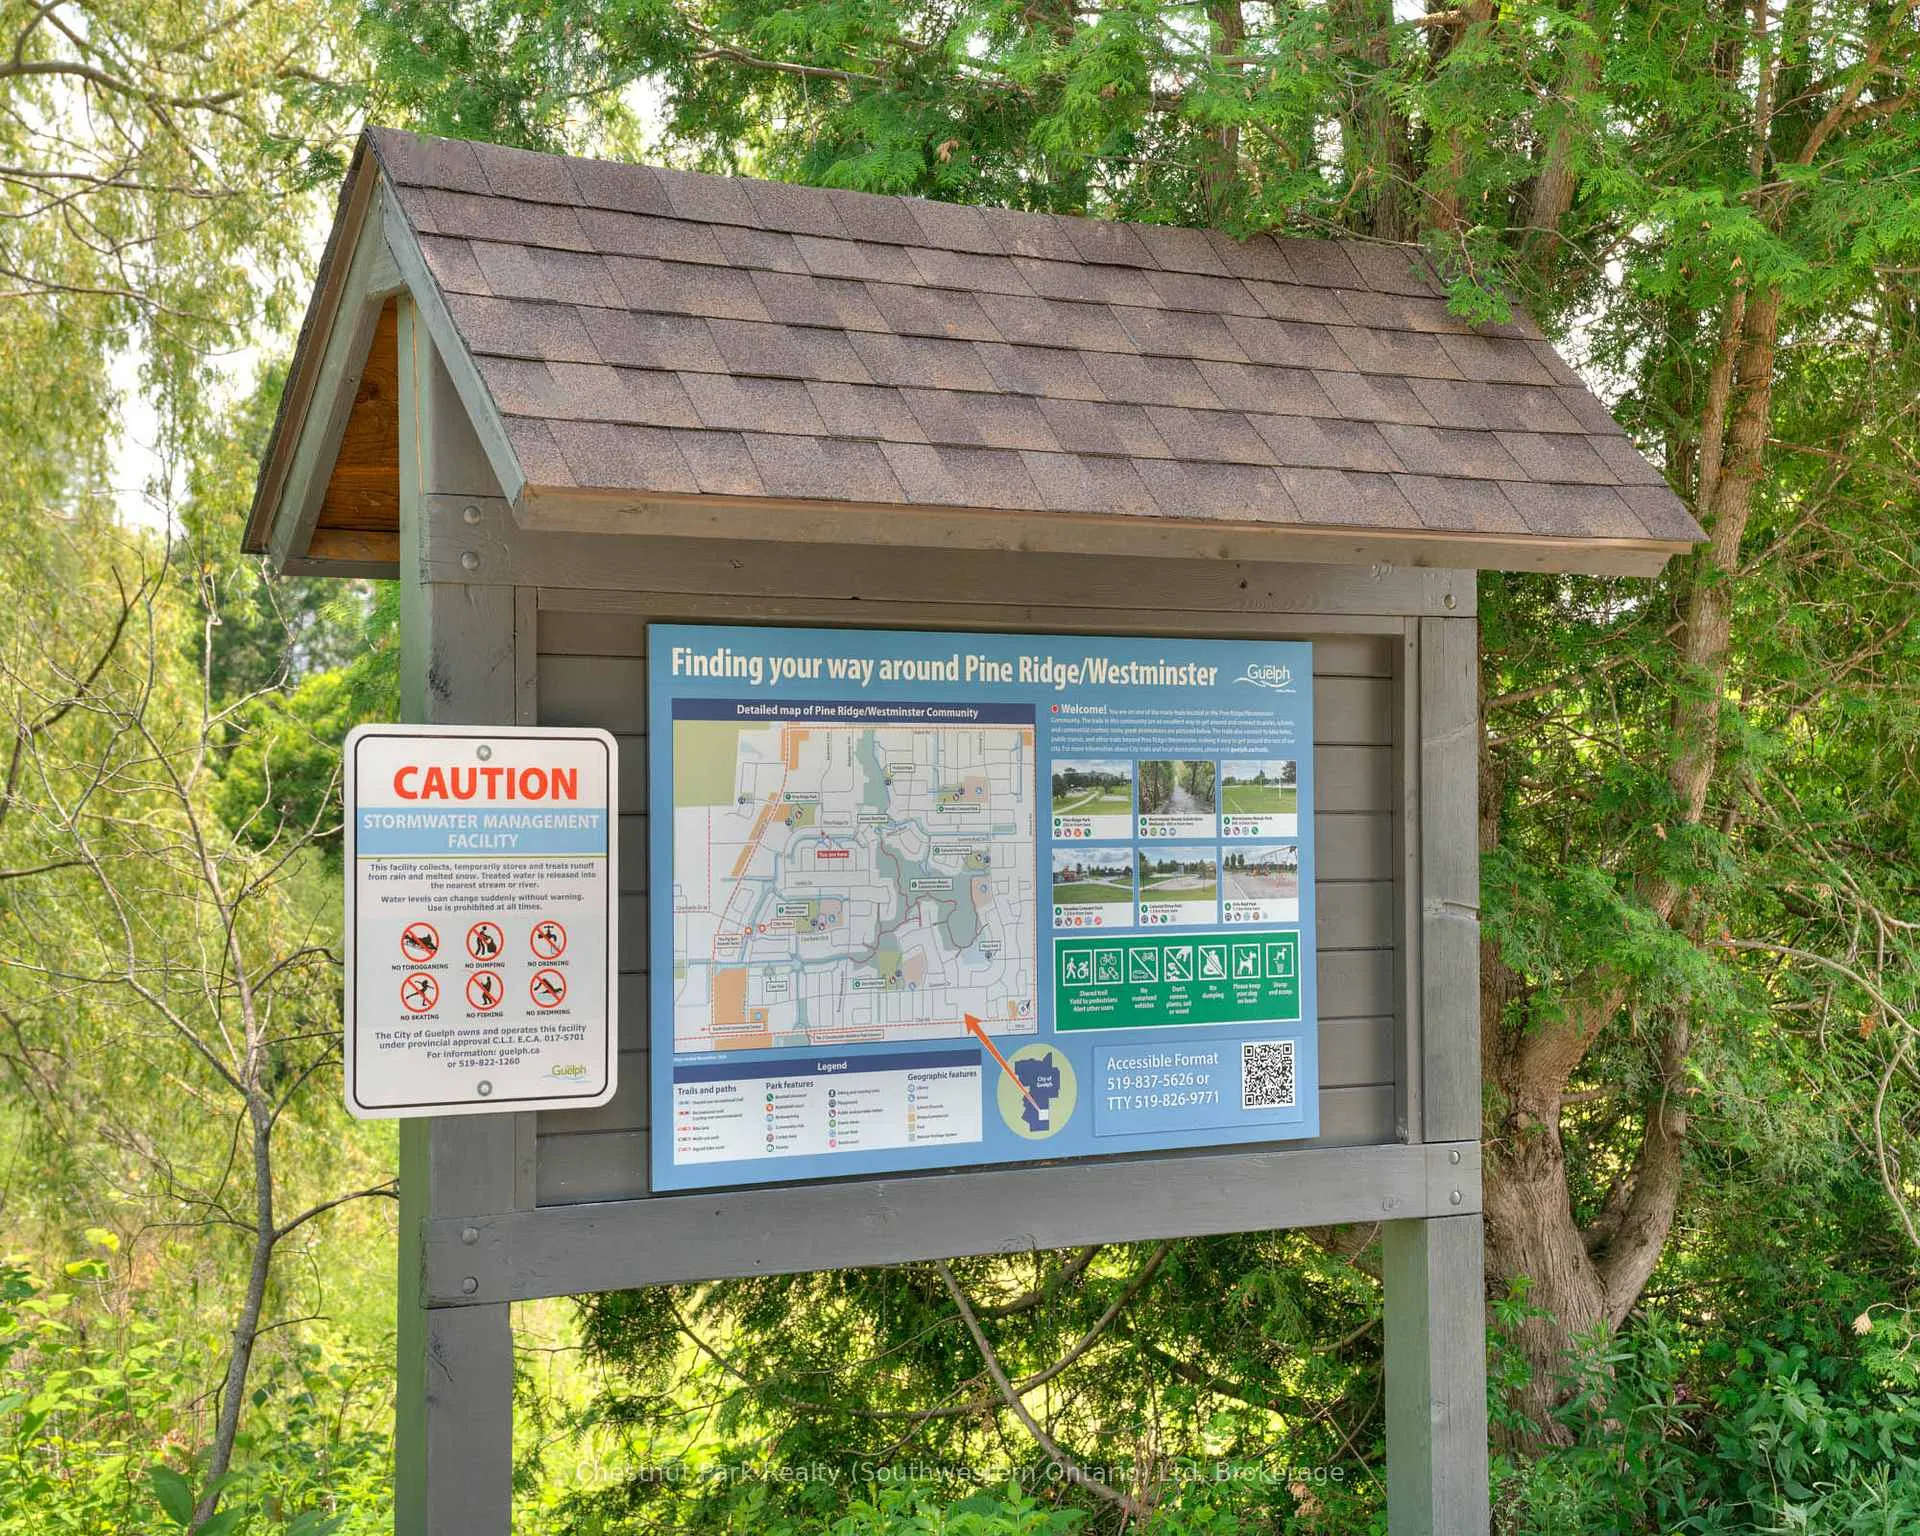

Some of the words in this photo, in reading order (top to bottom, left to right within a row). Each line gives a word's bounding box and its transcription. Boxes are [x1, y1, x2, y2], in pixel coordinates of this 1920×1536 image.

[672, 647, 763, 686] Finding
[770, 655, 822, 687] your
[826, 657, 874, 687] way
[879, 654, 959, 681] around
[965, 654, 1013, 683] Pine
[1019, 655, 1218, 691] Ridge/Westminster
[737, 704, 778, 715] Detailed
[780, 708, 801, 718] map
[803, 705, 813, 715] of
[815, 705, 836, 715] Pine
[838, 705, 925, 718] Ridge/Westminster
[927, 707, 979, 720] Community
[1061, 704, 1107, 714] Welcome!
[393, 766, 578, 800] CAUTION
[363, 814, 478, 829] STORMWATER
[483, 814, 600, 829] MANAGEMENT
[448, 834, 519, 849] FACILITY
[370, 863, 388, 871] This
[390, 863, 417, 872] facility
[454, 863, 500, 872] temporarily
[570, 862, 595, 870] runoff
[368, 873, 388, 881] from
[426, 872, 453, 880] melted
[546, 871, 579, 879] released
[581, 871, 597, 879] into
[518, 881, 540, 889] river.
[380, 895, 406, 903] Water
[408, 895, 431, 903] levels
[450, 895, 479, 903] change
[480, 894, 516, 902] suddenly
[550, 894, 585, 902] warning.
[453, 903, 494, 912] prohibited
[375, 1032, 391, 1040] The
[394, 1031, 411, 1040] City
[413, 1030, 422, 1038] of
[424, 1029, 455, 1039] Guelph
[501, 1026, 538, 1035] operates
[540, 1025, 556, 1033] this
[558, 1024, 587, 1033] facility
[379, 1041, 405, 1049] under
[407, 1039, 451, 1050] provincial
[452, 1037, 490, 1047] approval
[492, 1036, 515, 1044] C.L.I.
[517, 1035, 542, 1043] E.C.A.
[443, 1049, 497, 1058] information:
[499, 1047, 540, 1057] guelph.ca
[459, 1058, 520, 1068] 519-822-1260
[817, 1061, 848, 1073] Legend
[1106, 1053, 1172, 1071] Accessible
[1174, 1052, 1219, 1067] Format
[907, 1072, 948, 1082] Geographic
[949, 1071, 977, 1079] features
[1107, 1074, 1194, 1090] 519-837-5626
[1196, 1074, 1210, 1087] or
[678, 1087, 698, 1096] Trails
[699, 1086, 714, 1095] and
[715, 1085, 737, 1095] paths
[766, 1082, 783, 1090] Park
[783, 1080, 814, 1089] features
[1107, 1095, 1131, 1111] TTY
[1134, 1092, 1219, 1109] 519-826-9771
